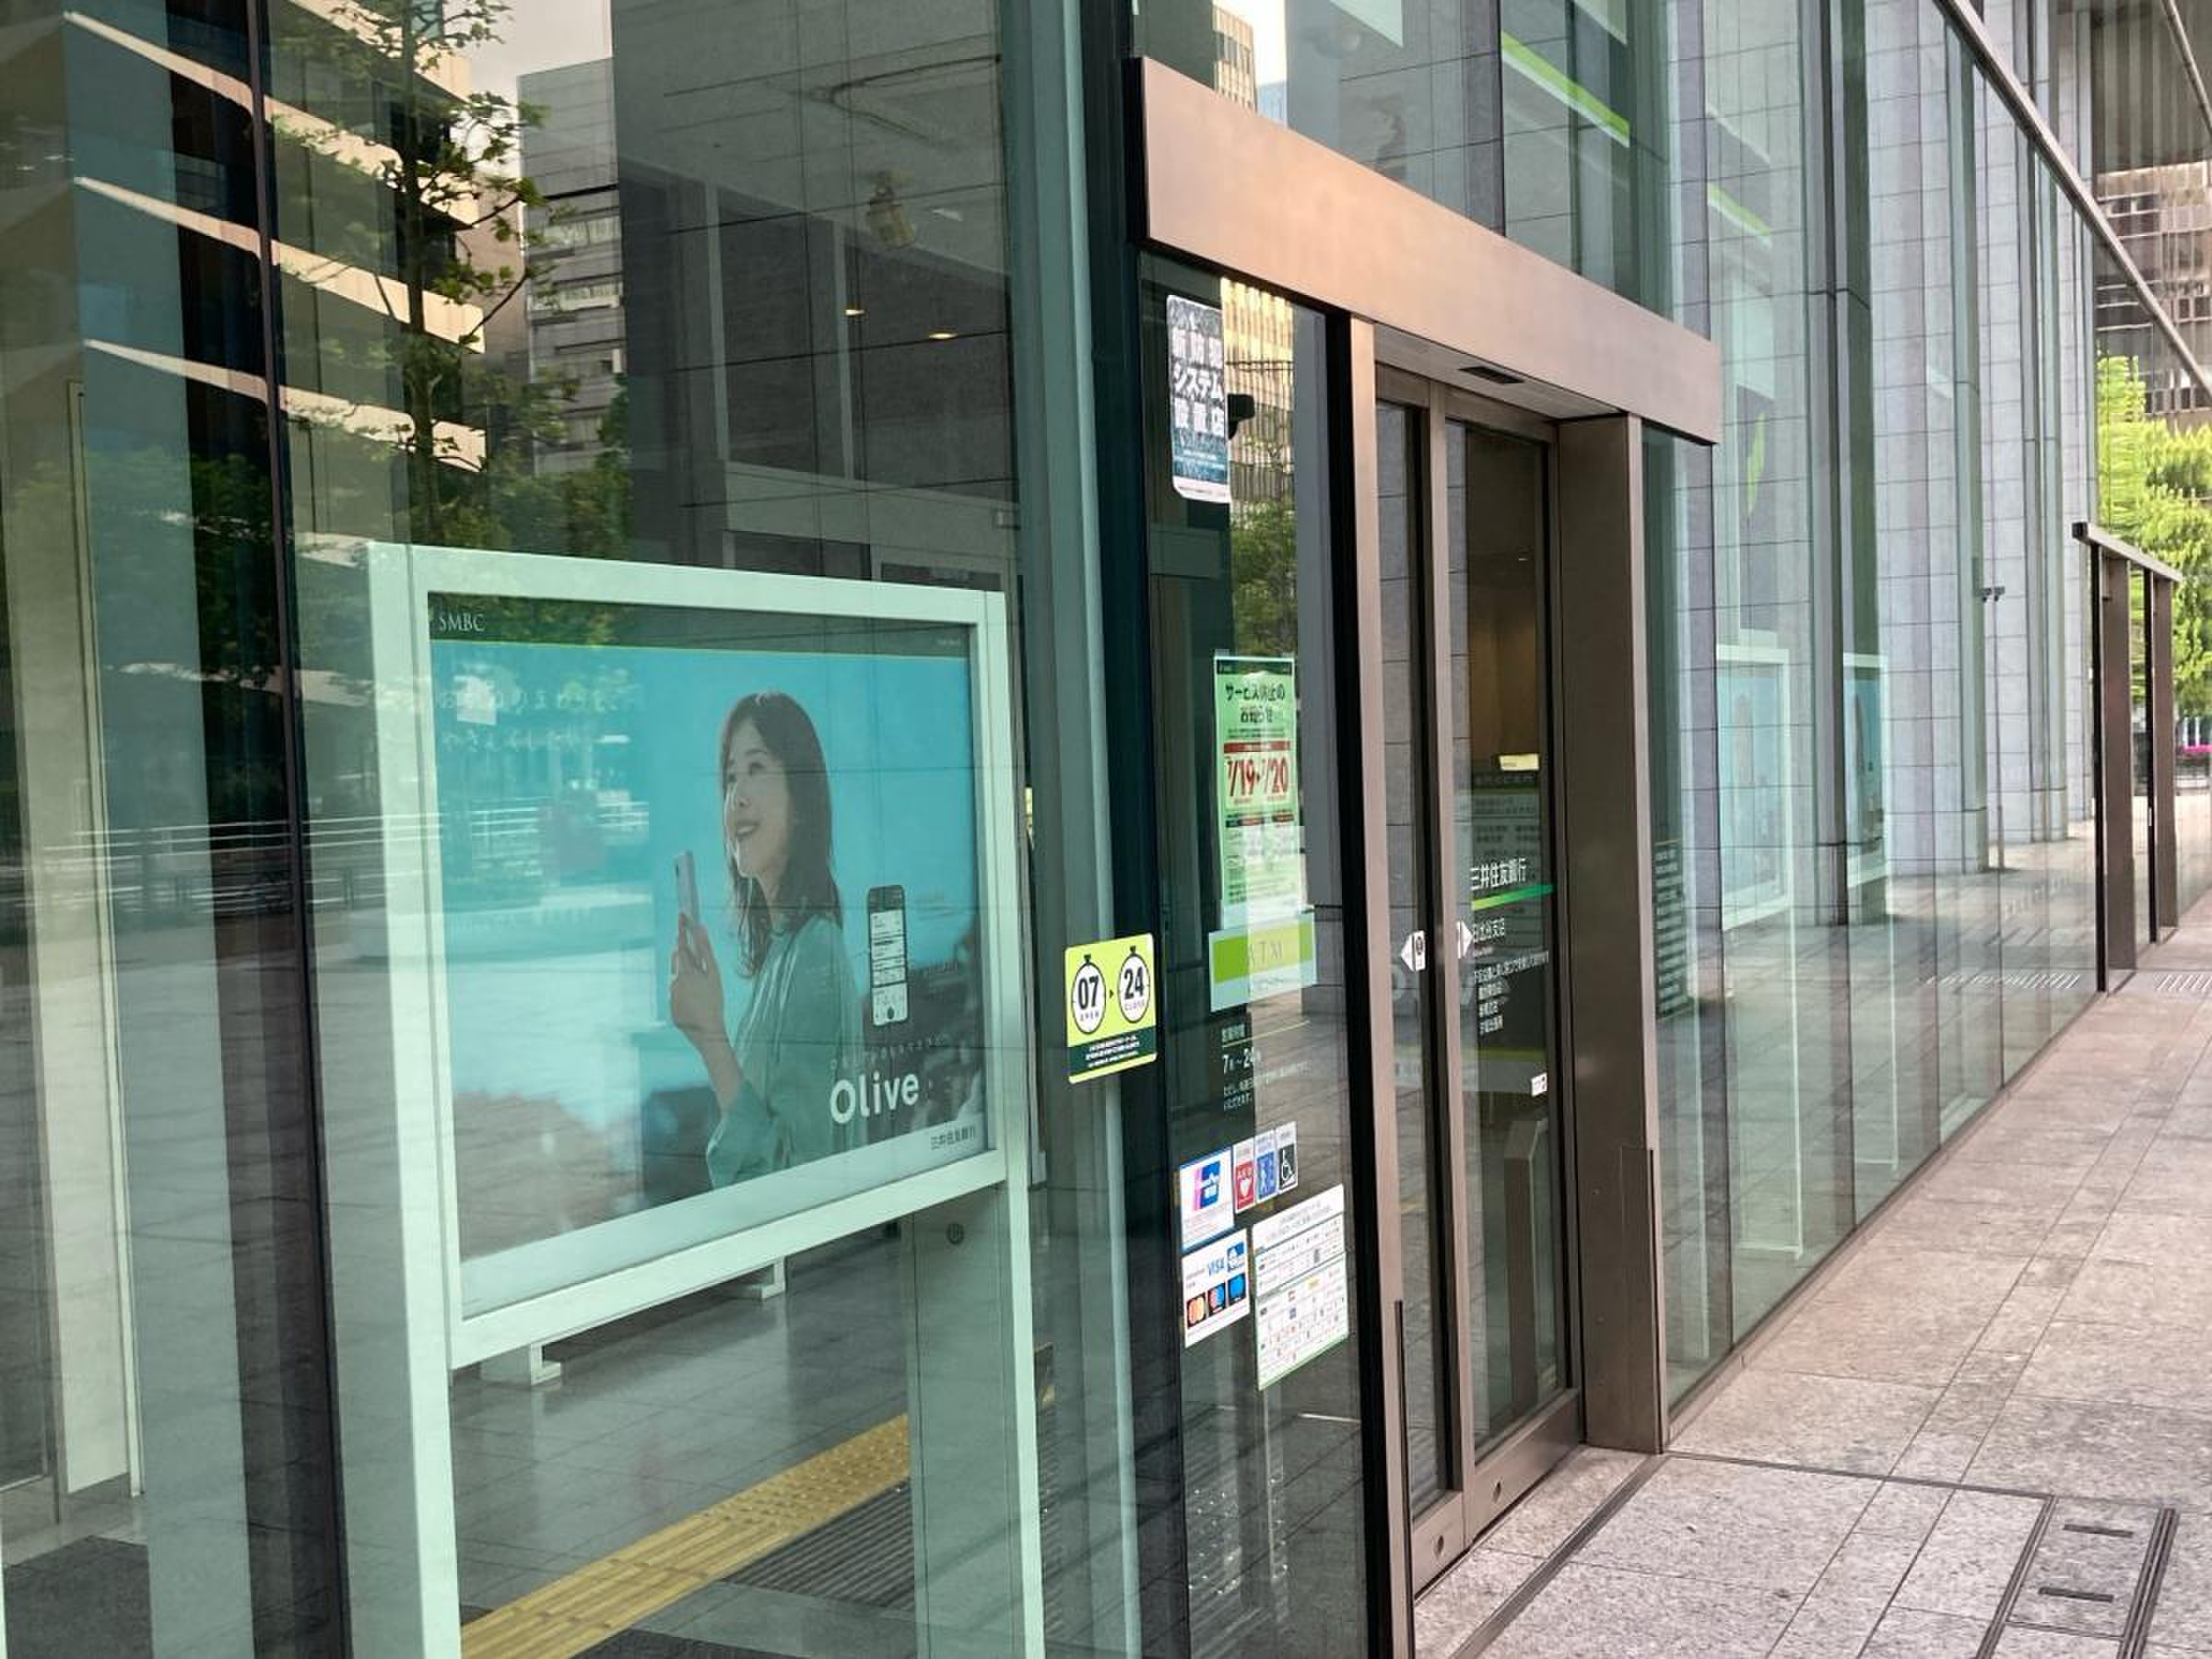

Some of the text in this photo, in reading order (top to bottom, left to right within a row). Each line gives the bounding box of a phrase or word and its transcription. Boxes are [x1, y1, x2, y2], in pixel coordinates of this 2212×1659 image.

[1173, 362, 1225, 401] システム
[439, 612, 486, 631] SMBC
[1470, 858, 1526, 890] 三井住友銀行
[1077, 975, 1100, 1009] 07
[1124, 966, 1145, 1000] 24
[830, 1071, 920, 1124] Olive
